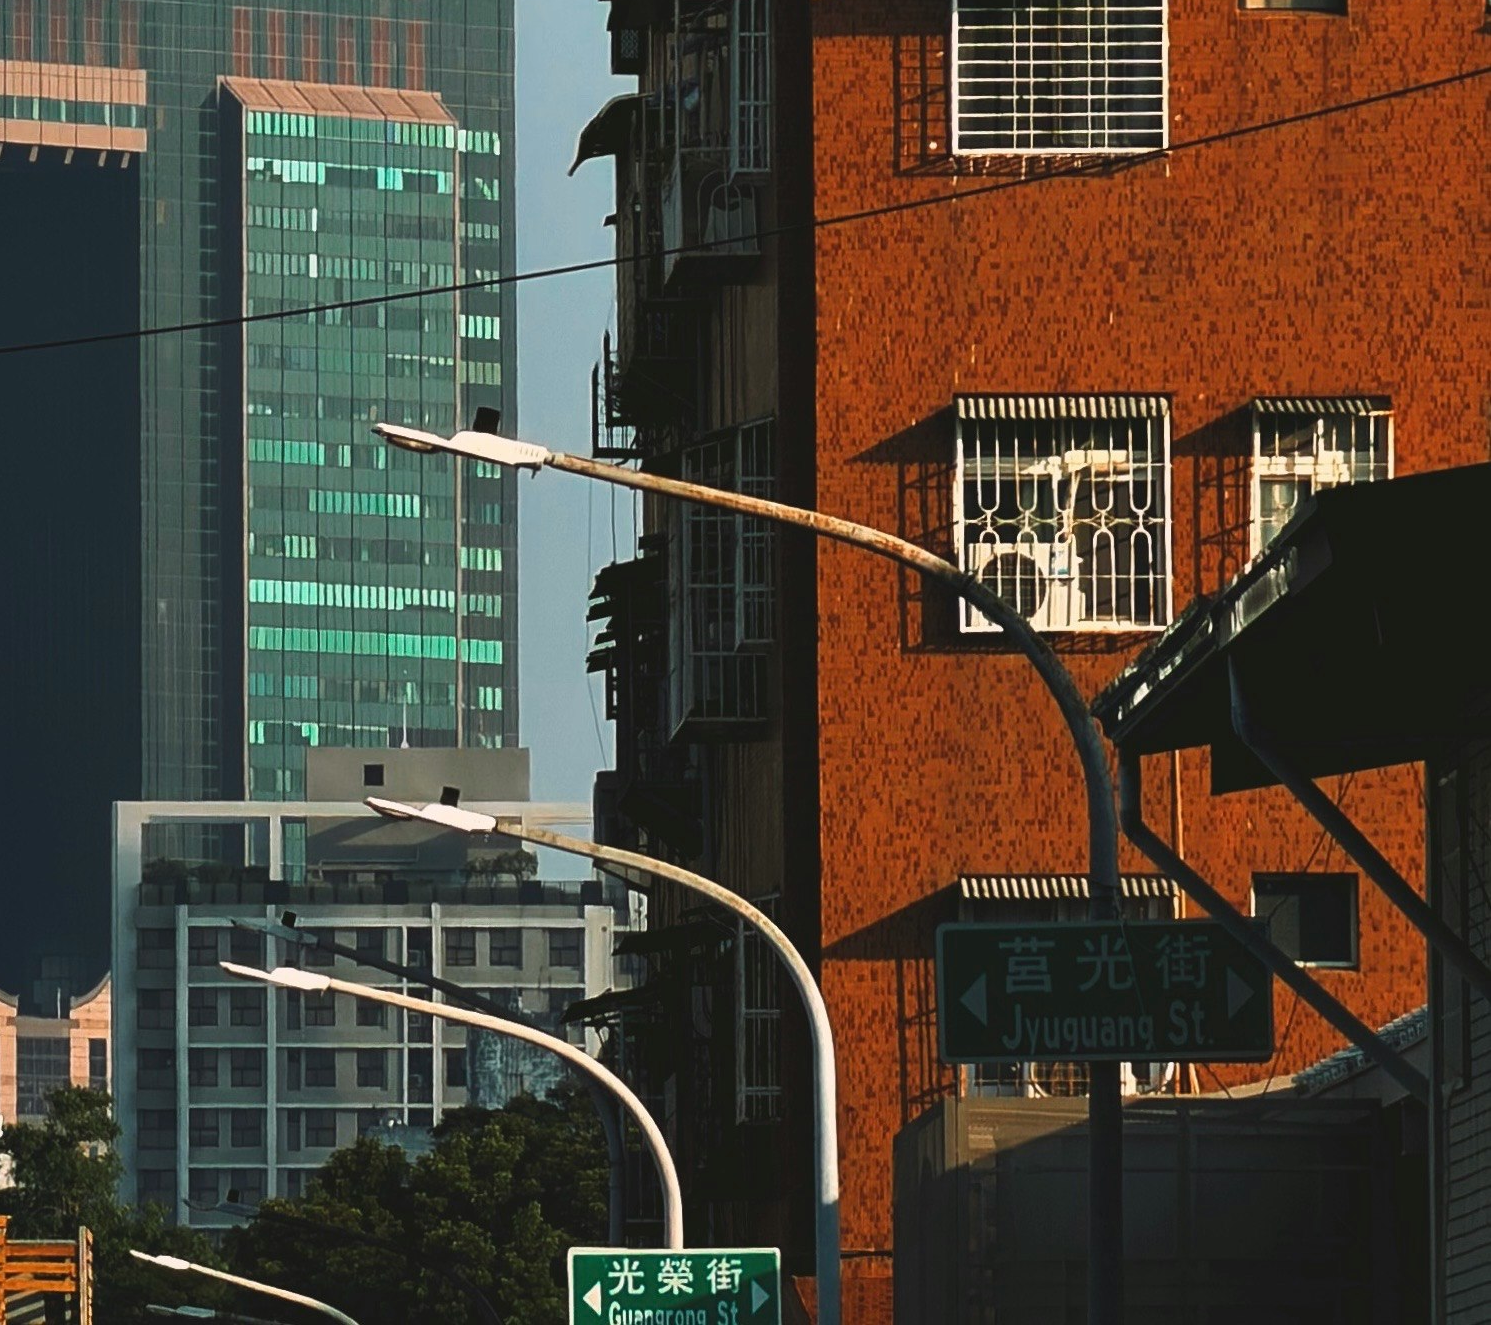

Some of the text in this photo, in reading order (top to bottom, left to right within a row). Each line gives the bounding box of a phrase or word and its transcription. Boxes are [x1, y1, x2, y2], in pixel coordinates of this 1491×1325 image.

[999, 934, 1211, 994] 莒光街
[1002, 1000, 1214, 1055] Jyuguang St.
[608, 1257, 743, 1294] 光榮街
